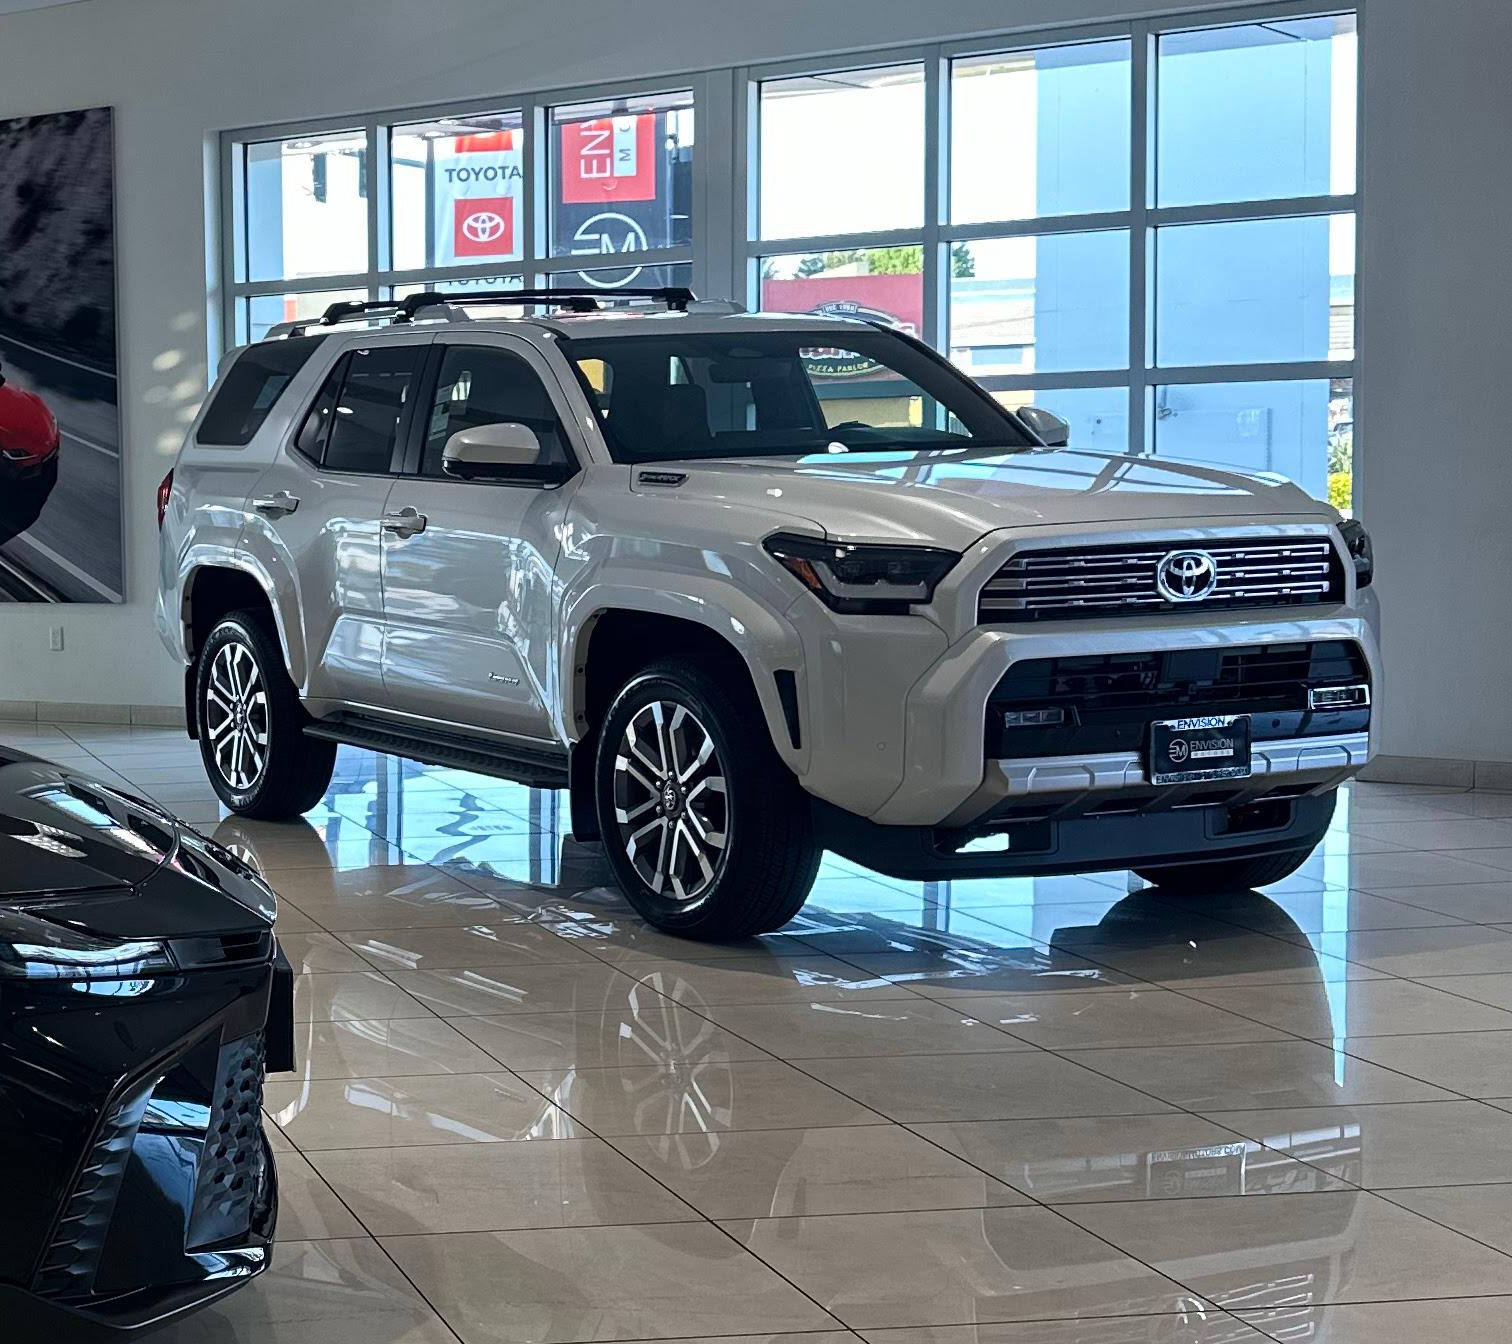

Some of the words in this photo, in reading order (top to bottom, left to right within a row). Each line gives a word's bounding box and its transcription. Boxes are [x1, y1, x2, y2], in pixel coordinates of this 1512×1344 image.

[445, 166, 523, 183] TOYOTA
[808, 364, 834, 373] PIZZA
[1177, 717, 1225, 729] ENVISION
[1190, 739, 1234, 751] ENVISION
